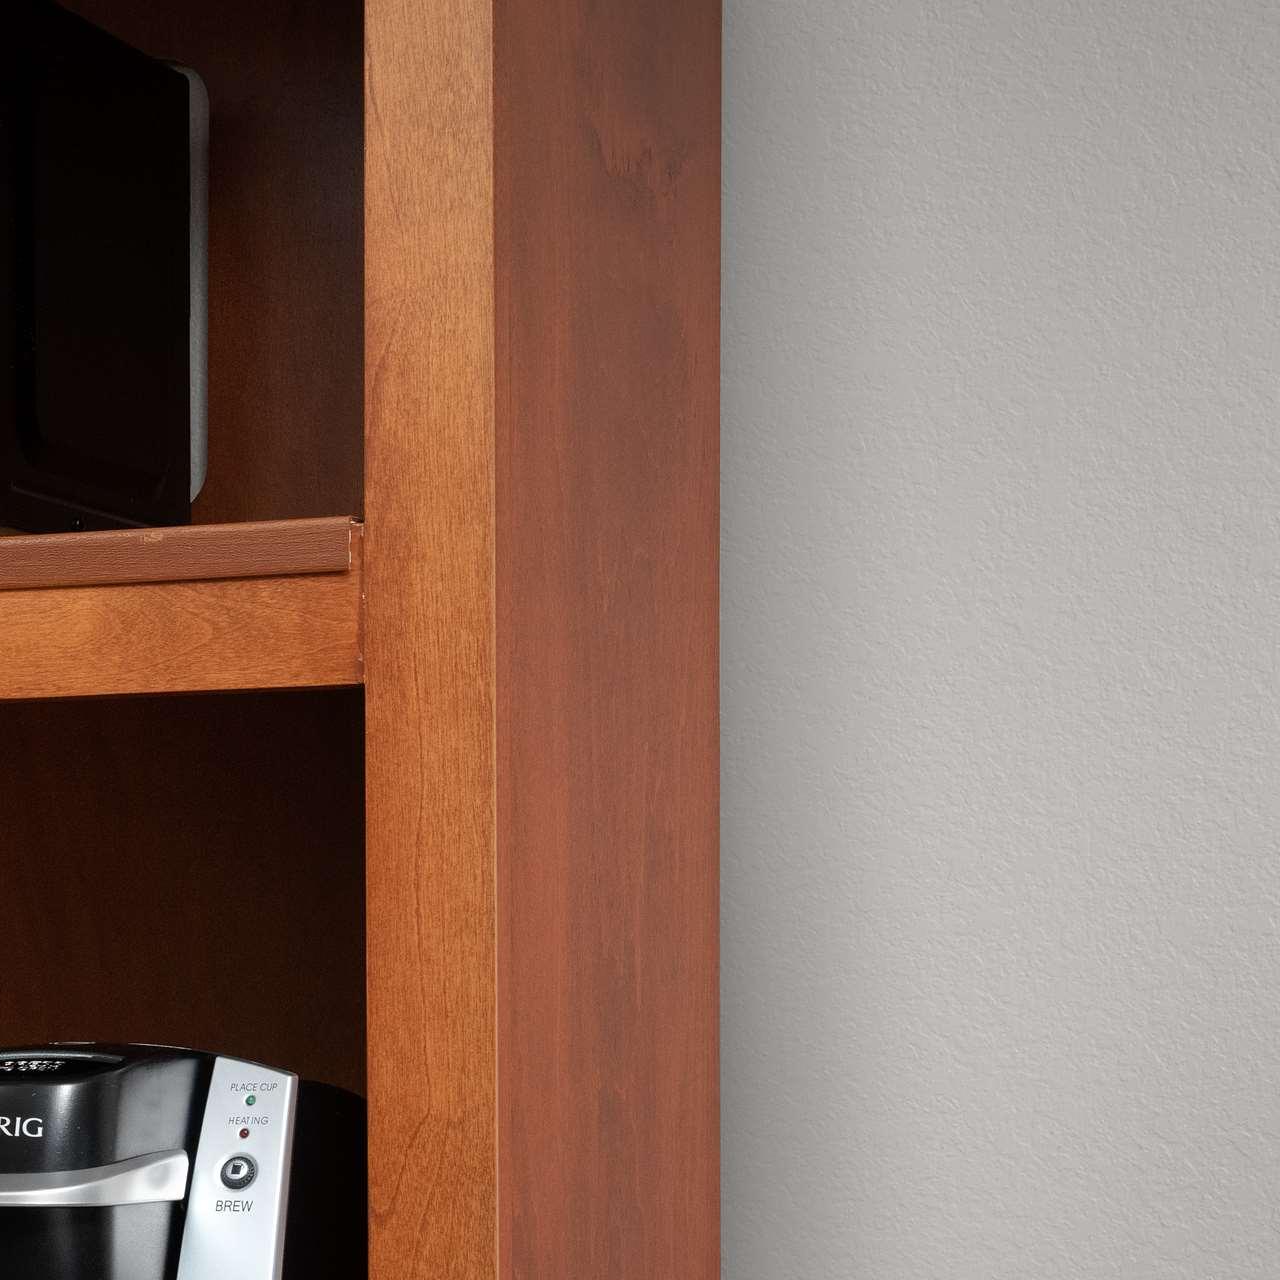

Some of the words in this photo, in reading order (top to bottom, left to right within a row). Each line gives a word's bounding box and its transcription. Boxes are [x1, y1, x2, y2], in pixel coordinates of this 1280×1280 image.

[230, 1082, 258, 1092] PLACE
[259, 1082, 278, 1092] CUP
[228, 1116, 269, 1125] HEATING
[215, 1200, 254, 1212] BREW
